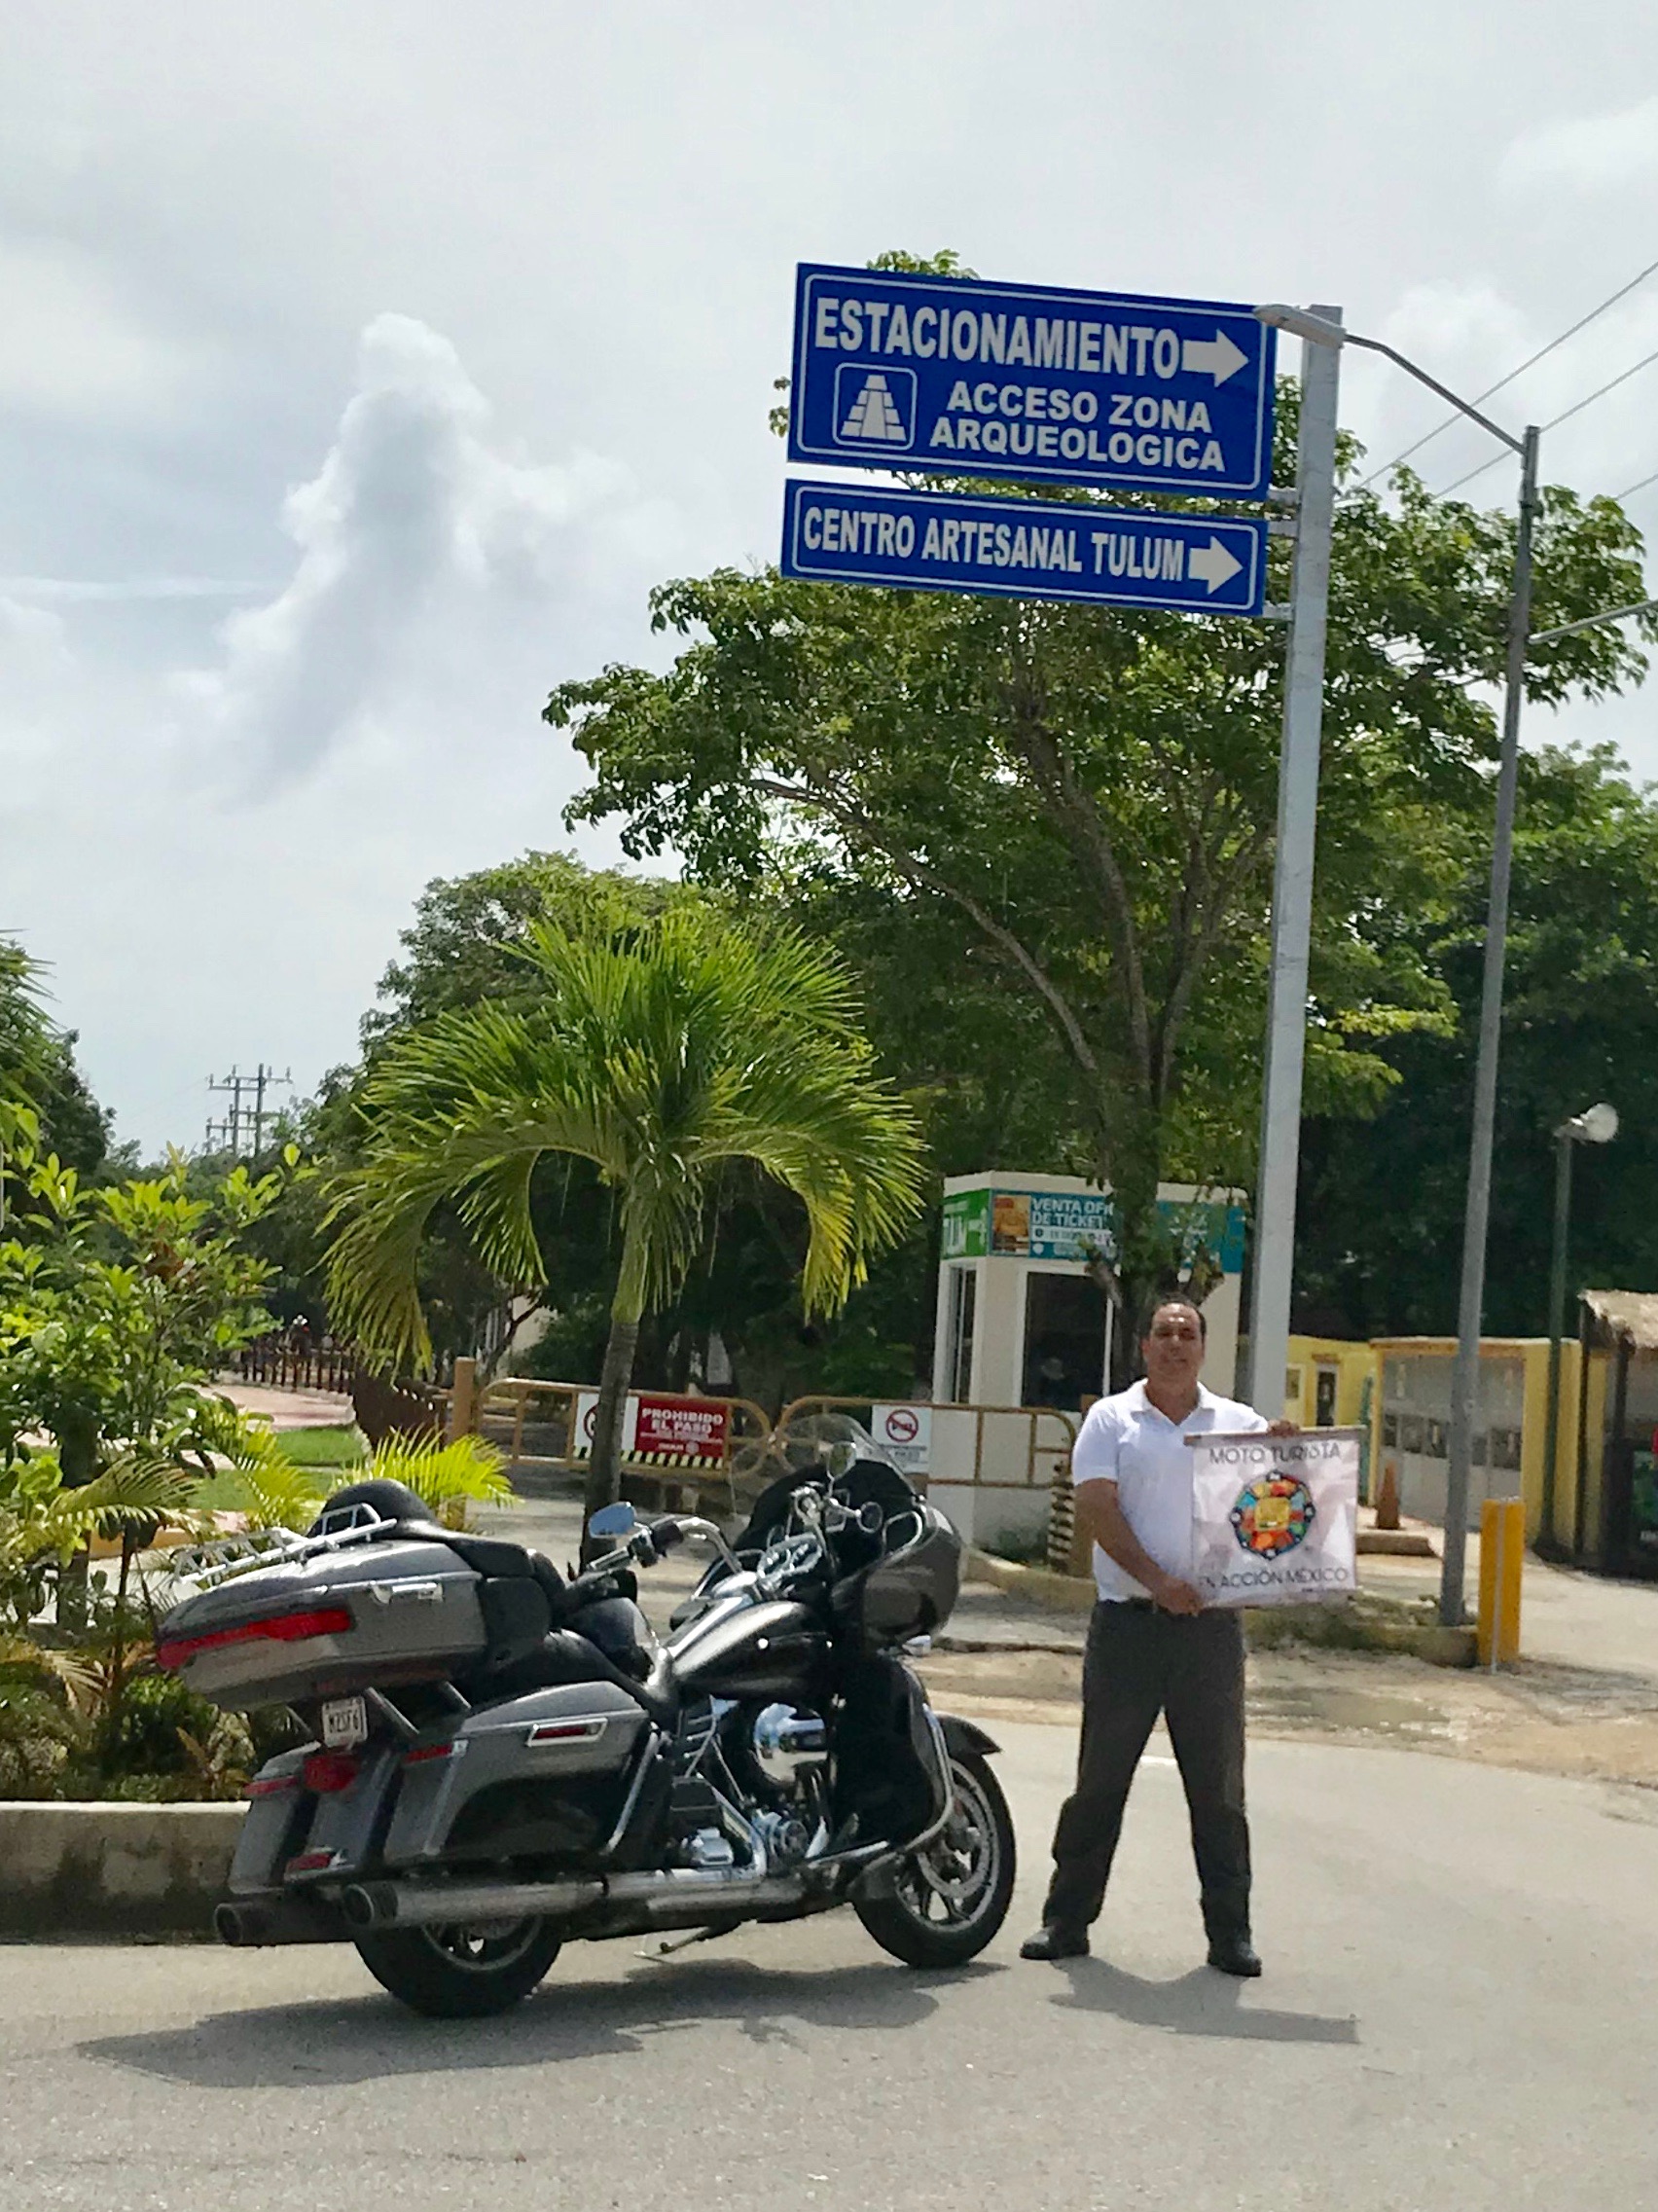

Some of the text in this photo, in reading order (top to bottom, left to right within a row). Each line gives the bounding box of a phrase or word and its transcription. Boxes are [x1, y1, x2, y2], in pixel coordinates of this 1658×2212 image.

[815, 298, 1179, 379] ESTACIONAMIENTO
[947, 381, 1212, 433] ACCESO ZONA
[929, 417, 1225, 472] ARQUEOLOGICA
[804, 507, 1184, 581] CENTRO ARTESANAL TULUM
[1032, 1198, 1082, 1214] VENTA
[1032, 1211, 1050, 1224] DE
[642, 1408, 723, 1425] PROHIBIDO
[652, 1419, 712, 1434] EL PASO
[1209, 1442, 1340, 1464] MOTO TURISTA
